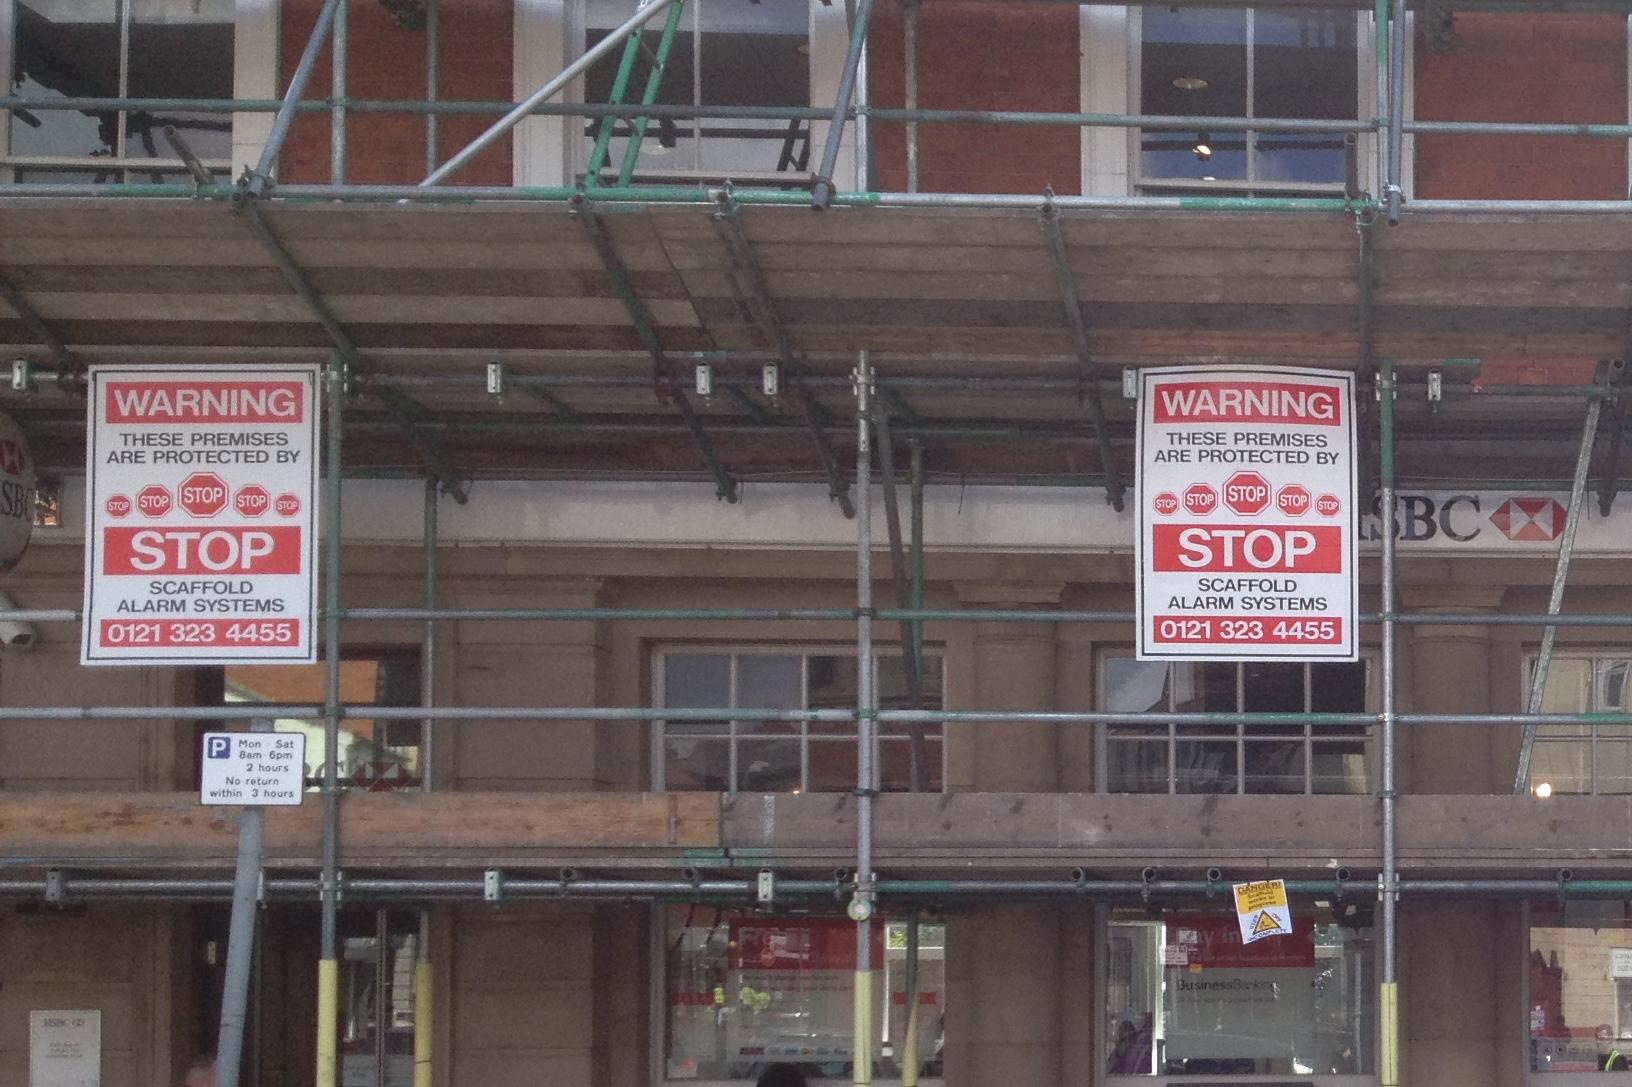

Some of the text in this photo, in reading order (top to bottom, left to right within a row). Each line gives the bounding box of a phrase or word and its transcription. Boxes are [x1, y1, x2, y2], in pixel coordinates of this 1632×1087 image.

[114, 388, 296, 416] WARNING
[1161, 389, 1334, 419] WARNING
[120, 432, 288, 447] THESE PREMISES
[1166, 432, 1328, 448] THESE PREMISES
[106, 450, 300, 464] ARE PROTECTED BY
[1154, 450, 1340, 465] ARE PROTECTED BY
[0, 480, 32, 522] SBC
[184, 487, 223, 503] STOP
[1186, 493, 1214, 506] STOP
[1228, 485, 1266, 502] STOP
[1280, 494, 1307, 507] STOP
[108, 500, 129, 512] STOP
[140, 495, 168, 508] STOP
[237, 495, 266, 508] STOP
[277, 500, 298, 511] STOP
[1155, 499, 1177, 509] STOP
[1318, 500, 1338, 511] STOP
[1359, 495, 1481, 541] SBC
[130, 531, 274, 571] STOP
[1178, 528, 1317, 569] STOP
[150, 581, 253, 595] SCAFFOLD
[1198, 579, 1297, 593] SCAFFOLD
[117, 598, 285, 613] ALARM SYSTEMS
[1168, 596, 1328, 611] ALARM SYSTEMS
[108, 623, 291, 643] 0121 323 4455
[1160, 620, 1335, 639] 0121 323 4455
[212, 739, 227, 757] P
[239, 740, 294, 749] Mon Sat
[246, 763, 289, 772] 2 hours
[226, 777, 279, 786] No return
[210, 788, 294, 798] within 3 hours
